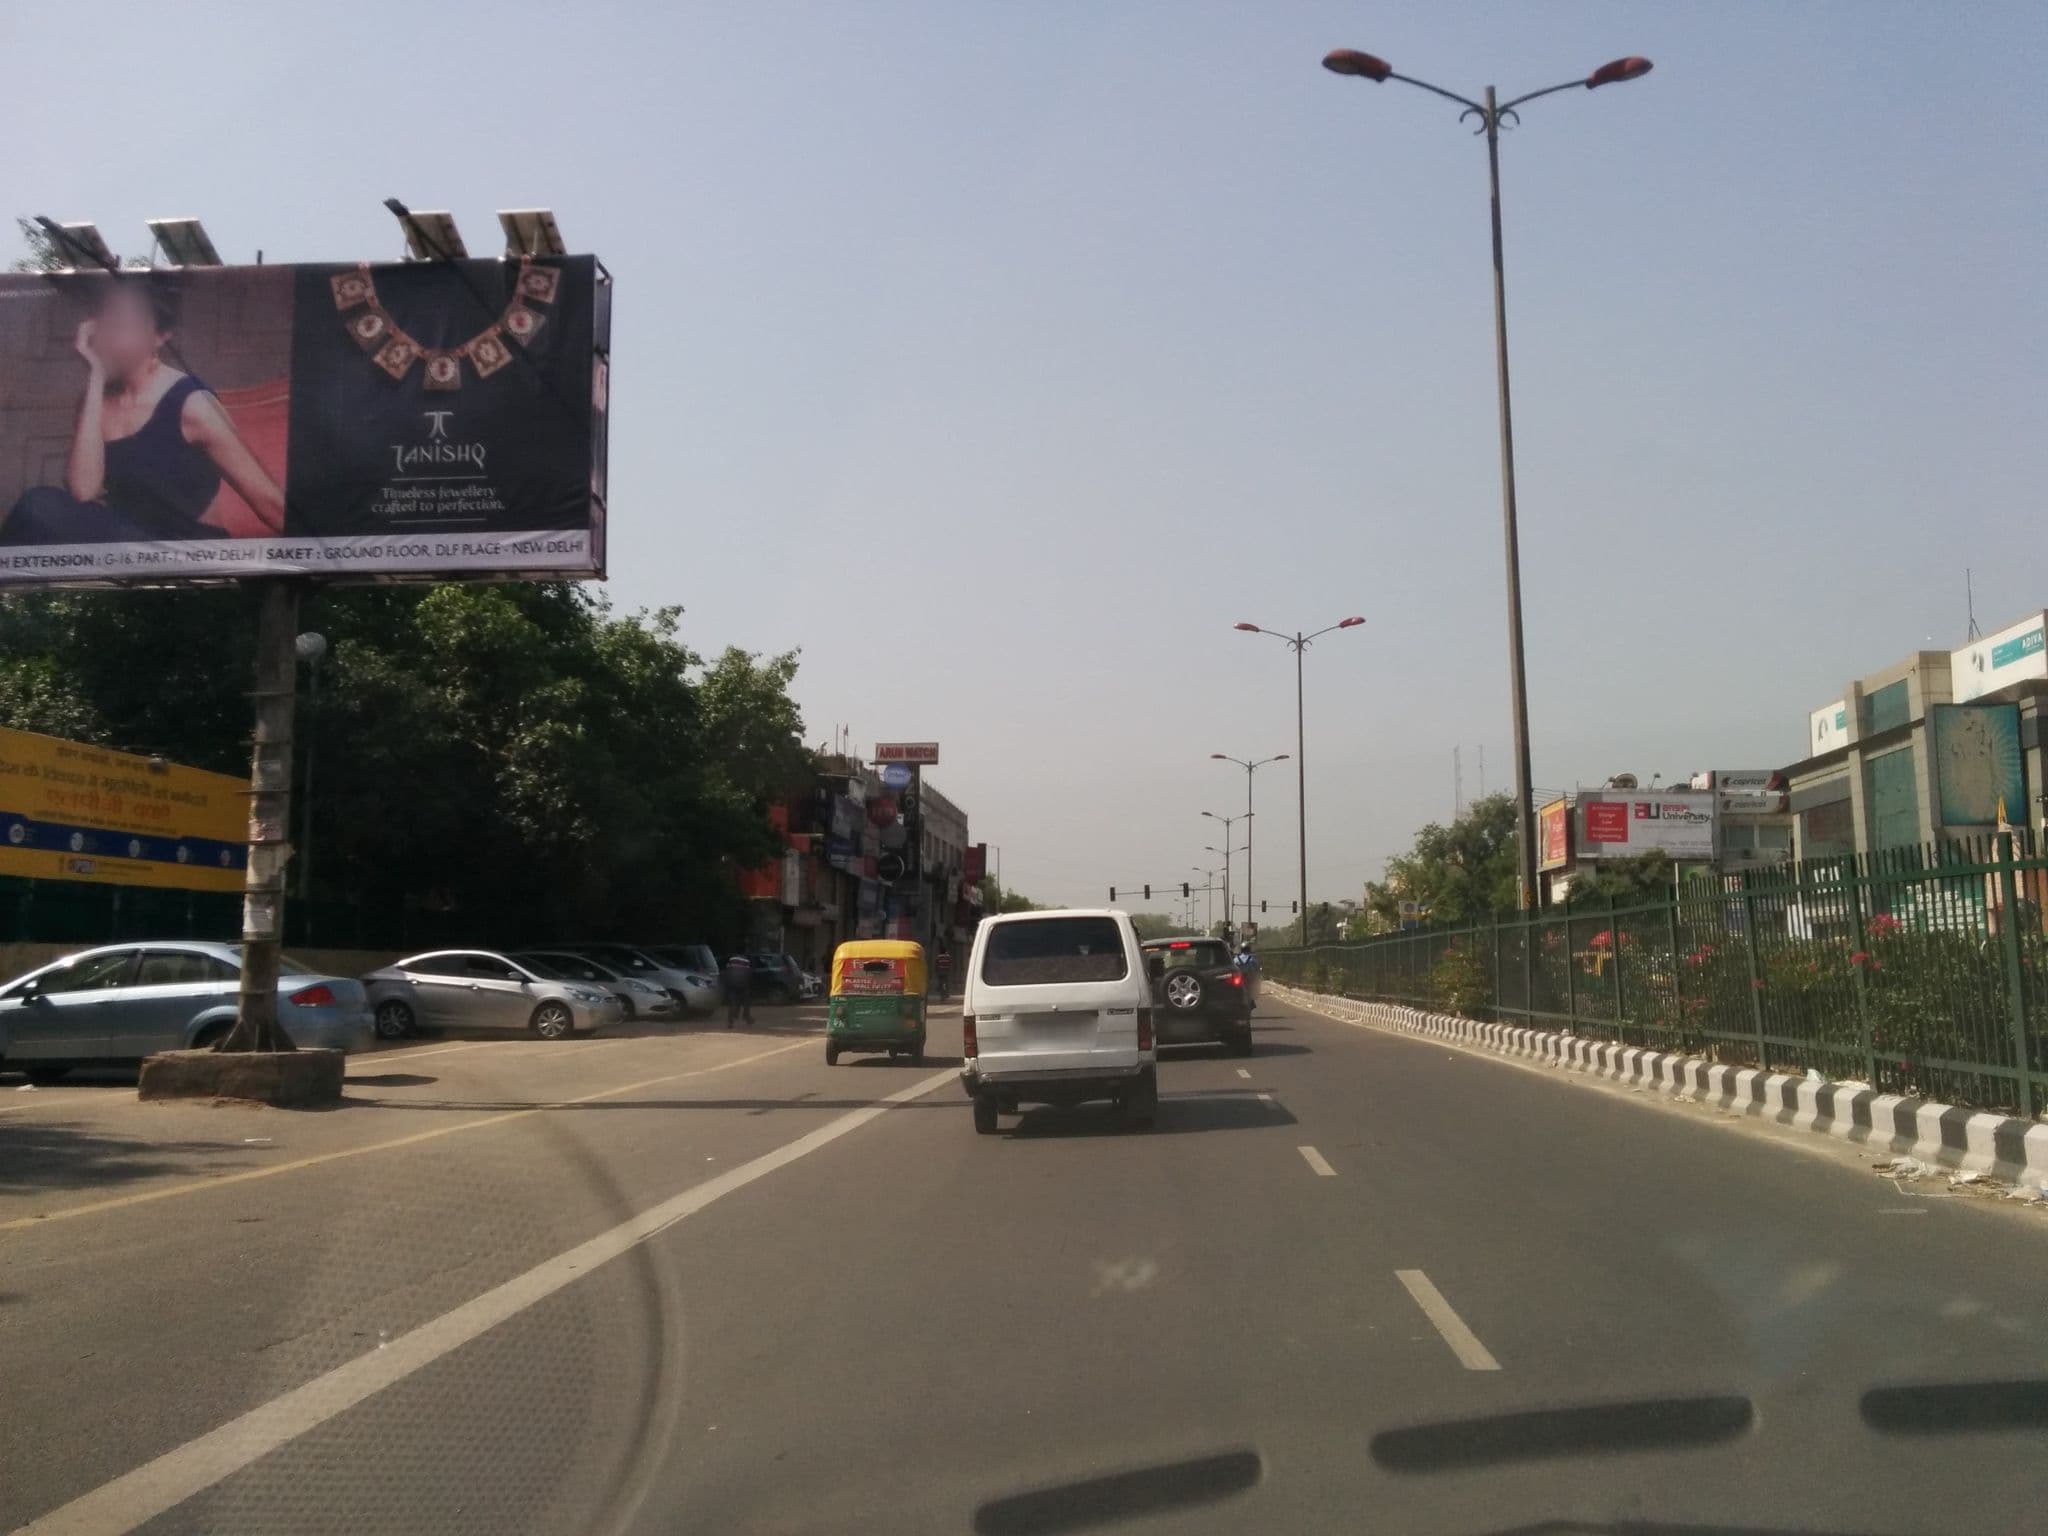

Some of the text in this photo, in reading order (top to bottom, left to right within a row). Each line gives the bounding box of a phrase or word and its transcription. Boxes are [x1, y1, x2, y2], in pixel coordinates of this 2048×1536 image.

[382, 487, 436, 499] Timeless
[371, 500, 417, 514] crafted
[420, 501, 434, 511] to
[13, 554, 94, 568] EXTENSION
[186, 551, 216, 562] NEW
[219, 549, 255, 561] DELHI
[266, 548, 312, 560] SAKET
[324, 546, 383, 559] GROUND
[436, 544, 458, 556] DLF
[462, 543, 500, 555] PLACE
[513, 542, 543, 554] NEW
[547, 541, 583, 553] DELHI
[879, 746, 937, 759] ARUN WATCH
[1662, 812, 1710, 824] University
